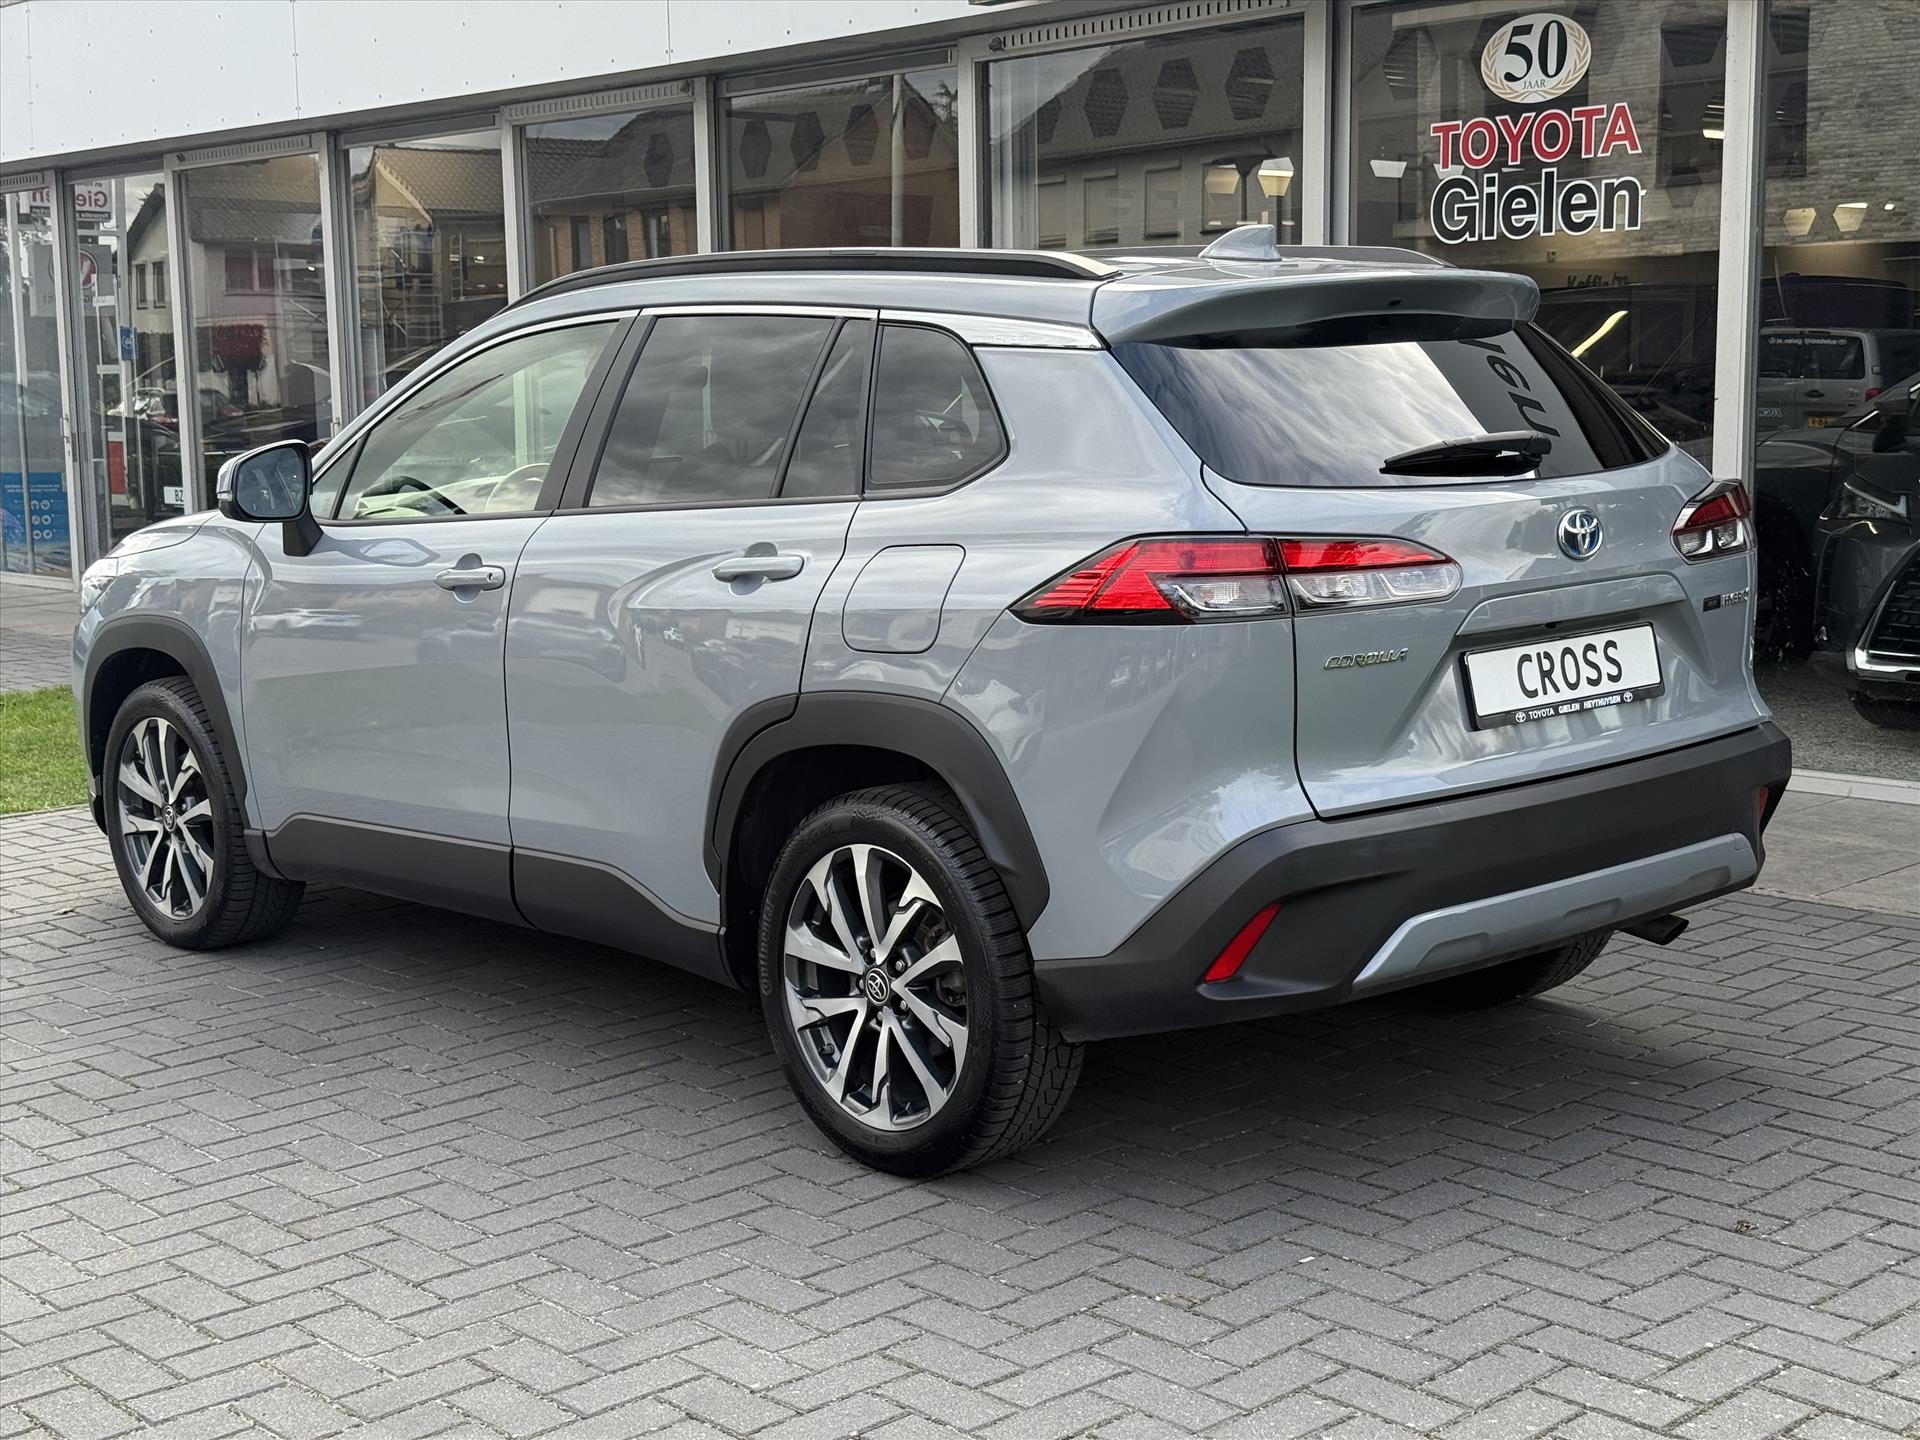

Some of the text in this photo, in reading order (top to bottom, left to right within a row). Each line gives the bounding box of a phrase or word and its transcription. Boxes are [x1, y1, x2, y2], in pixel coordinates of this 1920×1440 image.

[1504, 20, 1568, 82] 50
[1522, 79, 1547, 90] JAAR
[1430, 102, 1642, 172] TOYOTA
[1430, 168, 1642, 244] Gielen
[1323, 647, 1408, 670] COROLLA
[1517, 639, 1623, 699] CROSS
[1528, 696, 1621, 720] TOYOTA GIELEN HEYTHUYSEN
